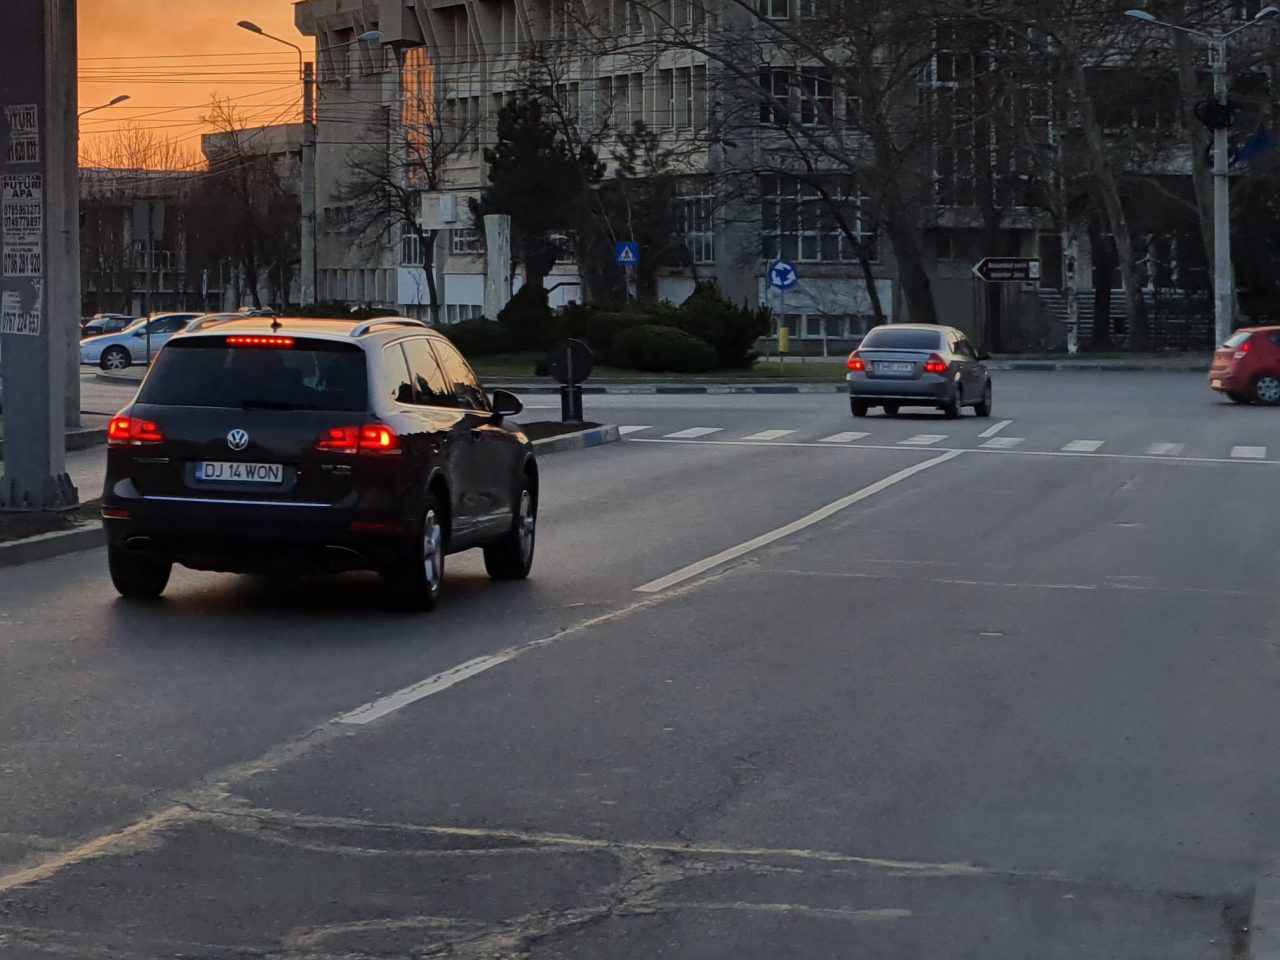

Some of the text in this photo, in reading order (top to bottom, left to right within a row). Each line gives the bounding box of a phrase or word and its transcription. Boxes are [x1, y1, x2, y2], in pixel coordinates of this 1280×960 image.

[12, 190, 33, 198] APA
[204, 464, 280, 480] DJ 14 WON
